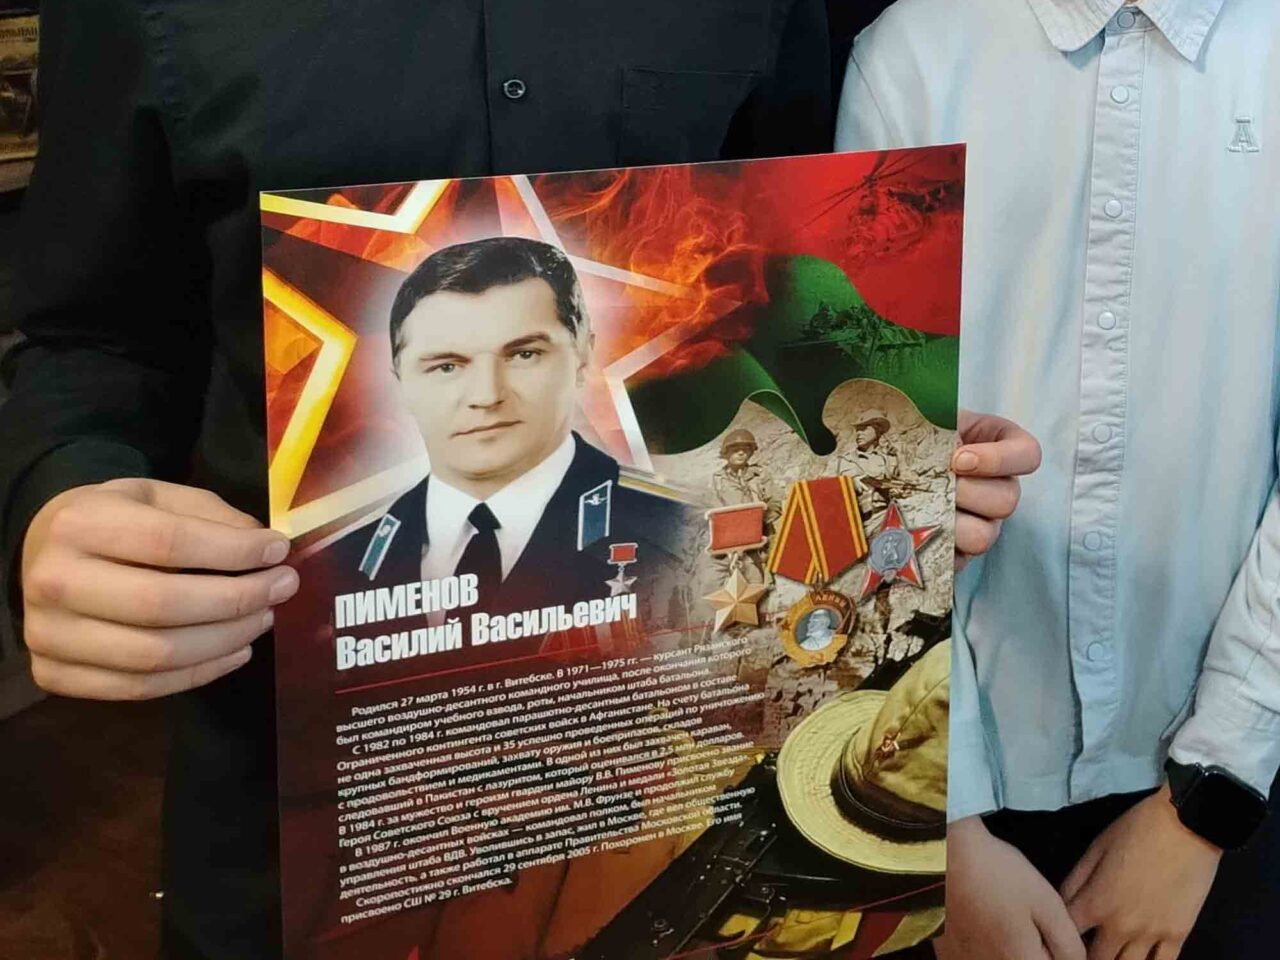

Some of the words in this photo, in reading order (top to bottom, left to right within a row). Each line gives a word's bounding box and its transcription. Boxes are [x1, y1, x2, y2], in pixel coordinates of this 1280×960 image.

[334, 573, 479, 629] ПИМЕНОВ
[336, 617, 463, 671] Василий
[471, 593, 638, 646] Васильевич
[336, 716, 384, 732] высшего
[387, 694, 505, 721] воздушно-десантного
[508, 682, 570, 698] командного
[572, 673, 619, 689] училища,
[622, 667, 650, 678] после
[653, 657, 705, 672] окончания
[708, 648, 750, 662] которого
[336, 734, 358, 744] был
[362, 720, 431, 739] командиром
[434, 710, 483, 727] учебного
[486, 703, 524, 715] взвода,
[527, 697, 555, 710] роты,
[557, 684, 624, 702] начальником
[627, 677, 656, 689] штаба
[659, 668, 709, 683] батальона.
[351, 701, 397, 716] Родился
[401, 696, 412, 706] 27
[416, 692, 447, 703] марта
[452, 684, 475, 696] 1954
[478, 684, 484, 692] г.
[505, 673, 554, 686] Витебске.
[557, 669, 562, 677] В
[567, 658, 624, 674] 1971—1975
[653, 647, 691, 661] курсант
[352, 745, 359, 754] С
[364, 739, 388, 751] 1982
[392, 738, 405, 746] по
[409, 730, 433, 742] 1984
[446, 718, 509, 735] командовал
[512, 695, 630, 722] парашютно-десантным
[632, 683, 690, 700] батальоном
[700, 674, 736, 687] составе
[336, 747, 423, 770] Ограниченного
[426, 734, 491, 752] контингента
[494, 723, 546, 739] советских
[549, 717, 578, 727] войск
[589, 703, 654, 721] Афганистане.
[657, 698, 669, 707] На
[672, 694, 698, 704] счету
[700, 683, 748, 699] батальона
[338, 780, 385, 797] крупных
[388, 756, 499, 785] бандформирований,
[502, 749, 540, 762] захвату
[543, 741, 581, 755] оружия
[593, 727, 659, 744] боеприпасов,
[662, 717, 701, 731] складов
[341, 903, 401, 923] присвоено
[403, 896, 421, 907] СШ
[438, 889, 450, 899] 29
[453, 888, 459, 896] г.
[462, 877, 511, 892] Витебска.
